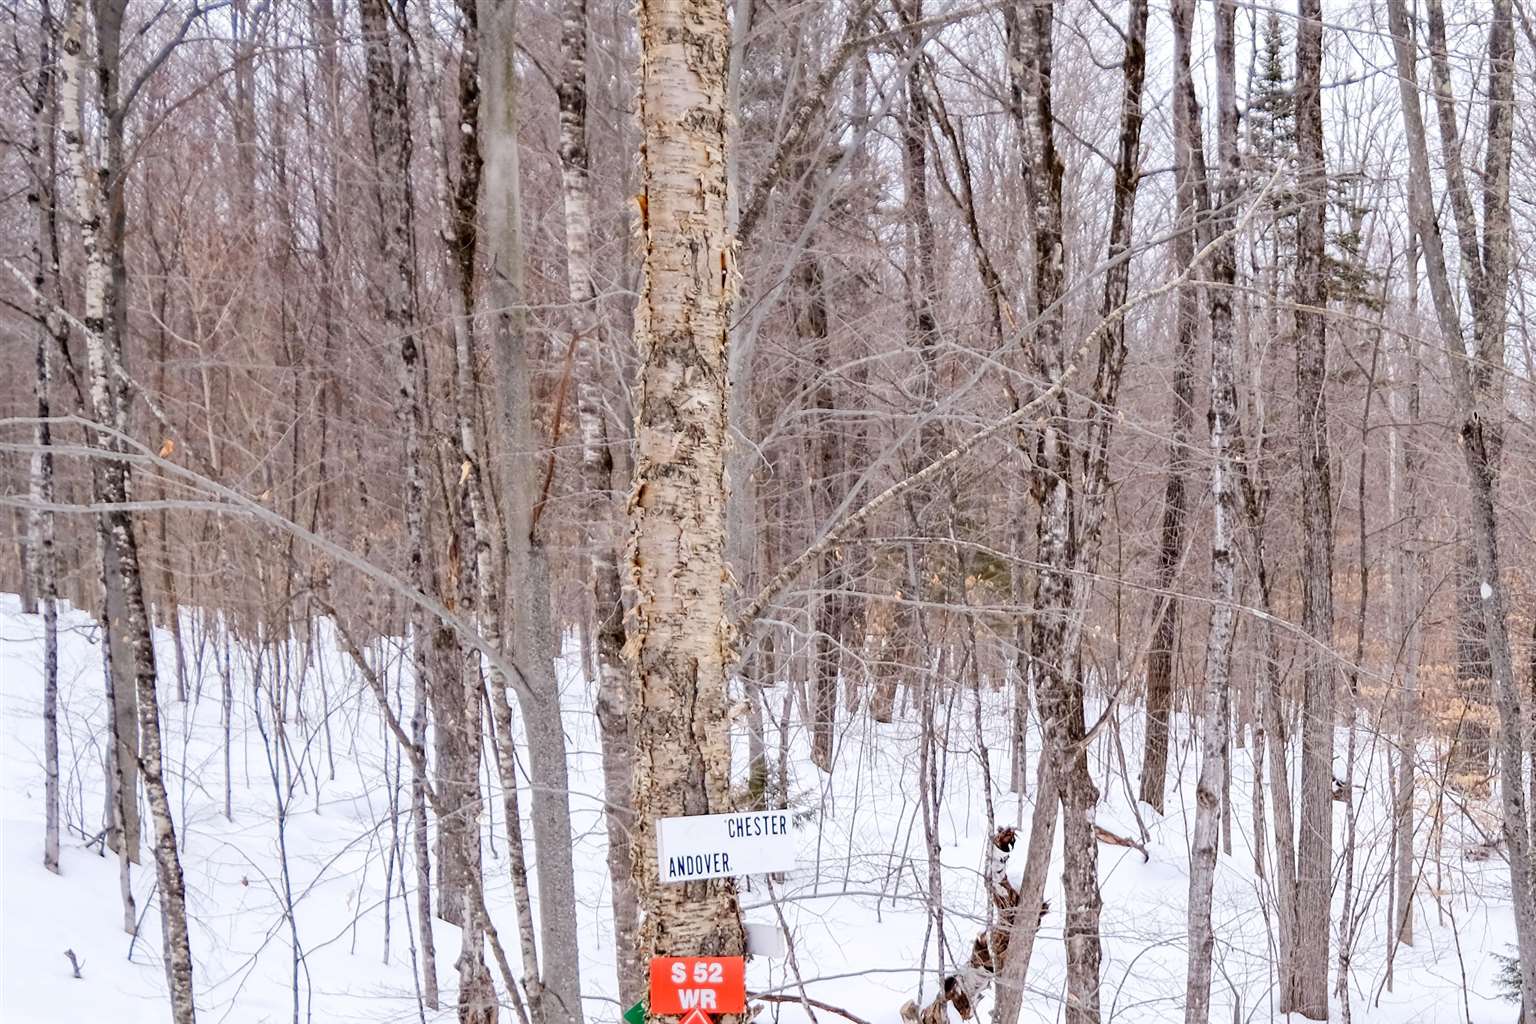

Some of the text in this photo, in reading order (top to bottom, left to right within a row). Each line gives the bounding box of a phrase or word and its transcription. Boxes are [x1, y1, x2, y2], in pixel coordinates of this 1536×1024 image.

[727, 815, 787, 838] CHESTER
[669, 852, 729, 877] ANDOVER
[671, 962, 724, 984] S 52
[678, 988, 717, 1010] WR
